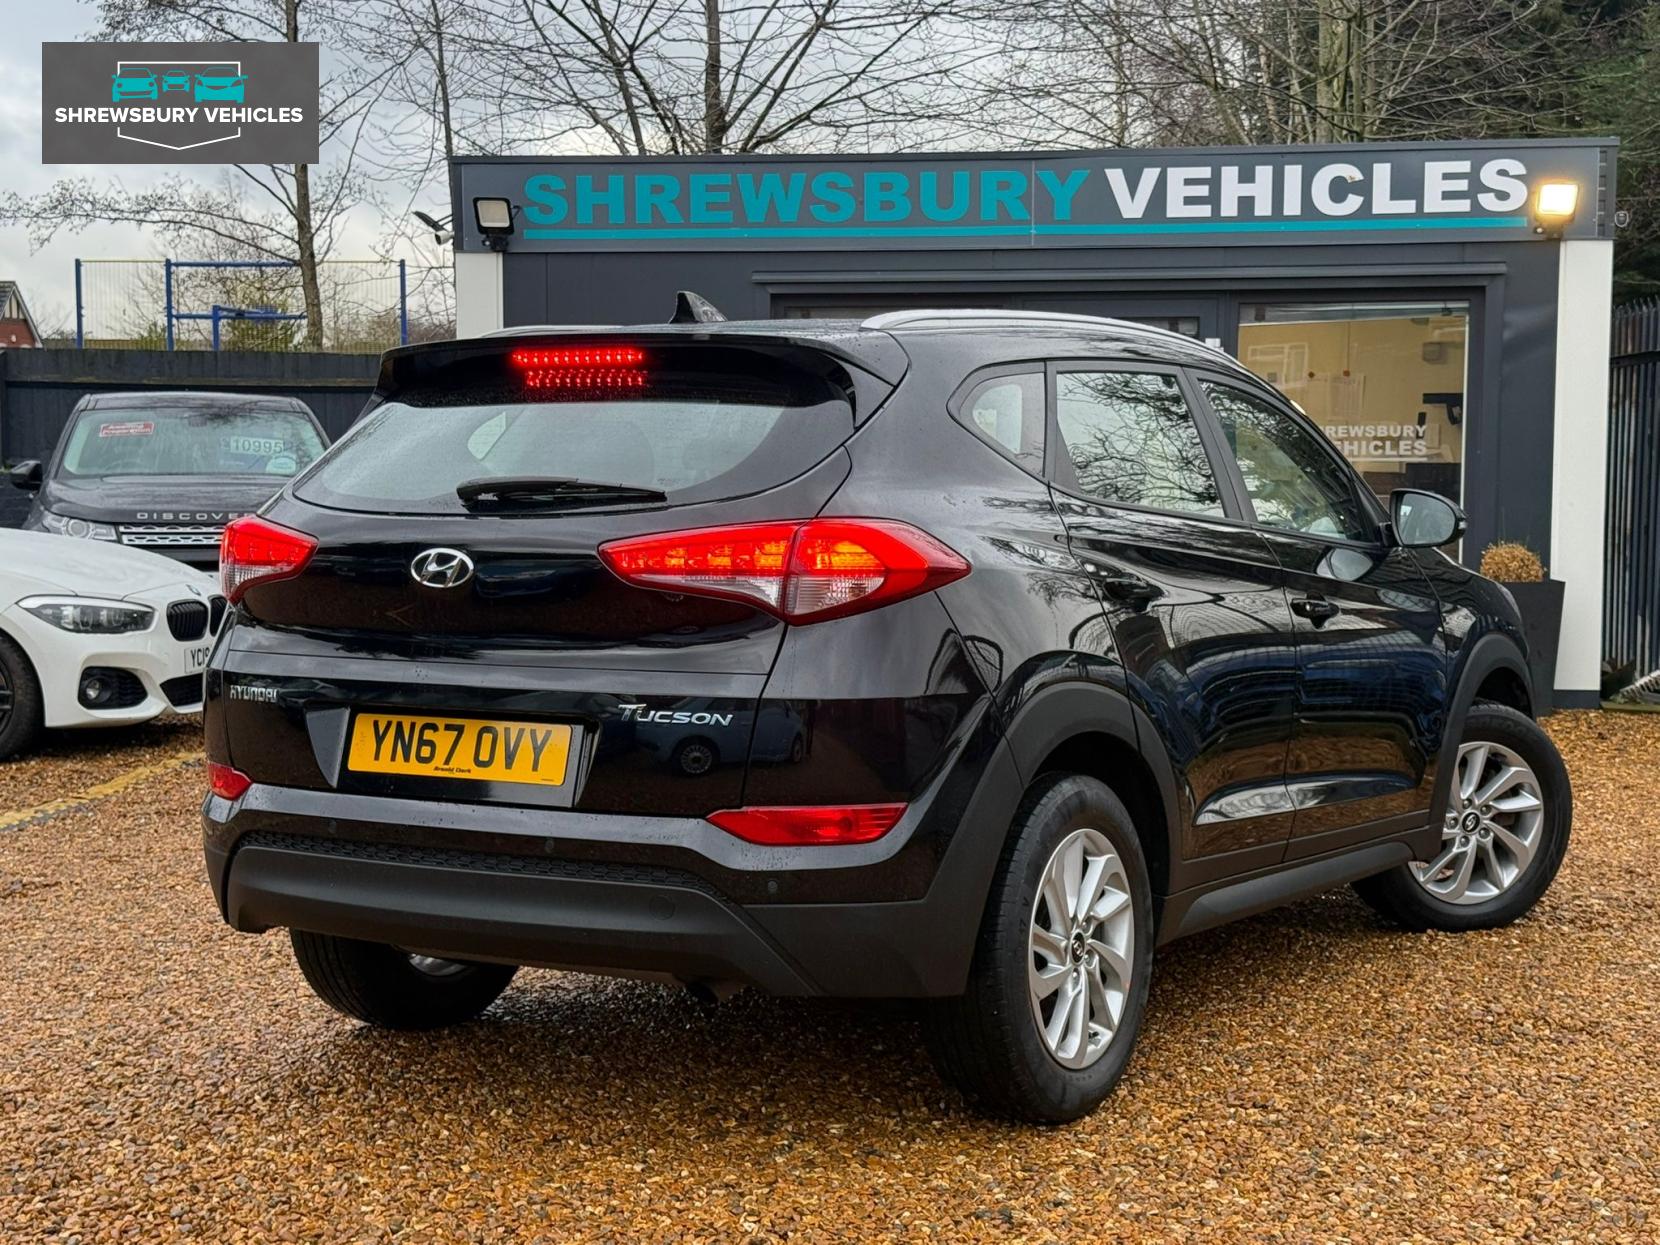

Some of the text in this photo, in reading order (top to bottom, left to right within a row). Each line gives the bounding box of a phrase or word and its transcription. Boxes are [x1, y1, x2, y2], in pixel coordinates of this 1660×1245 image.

[523, 158, 1528, 225] SHREWSBURY VEHICLES
[1320, 424, 1427, 438] REWSBURY
[232, 438, 283, 454] 10995
[229, 685, 279, 702] HYUNDAI
[372, 719, 553, 772] YN67 OVY
